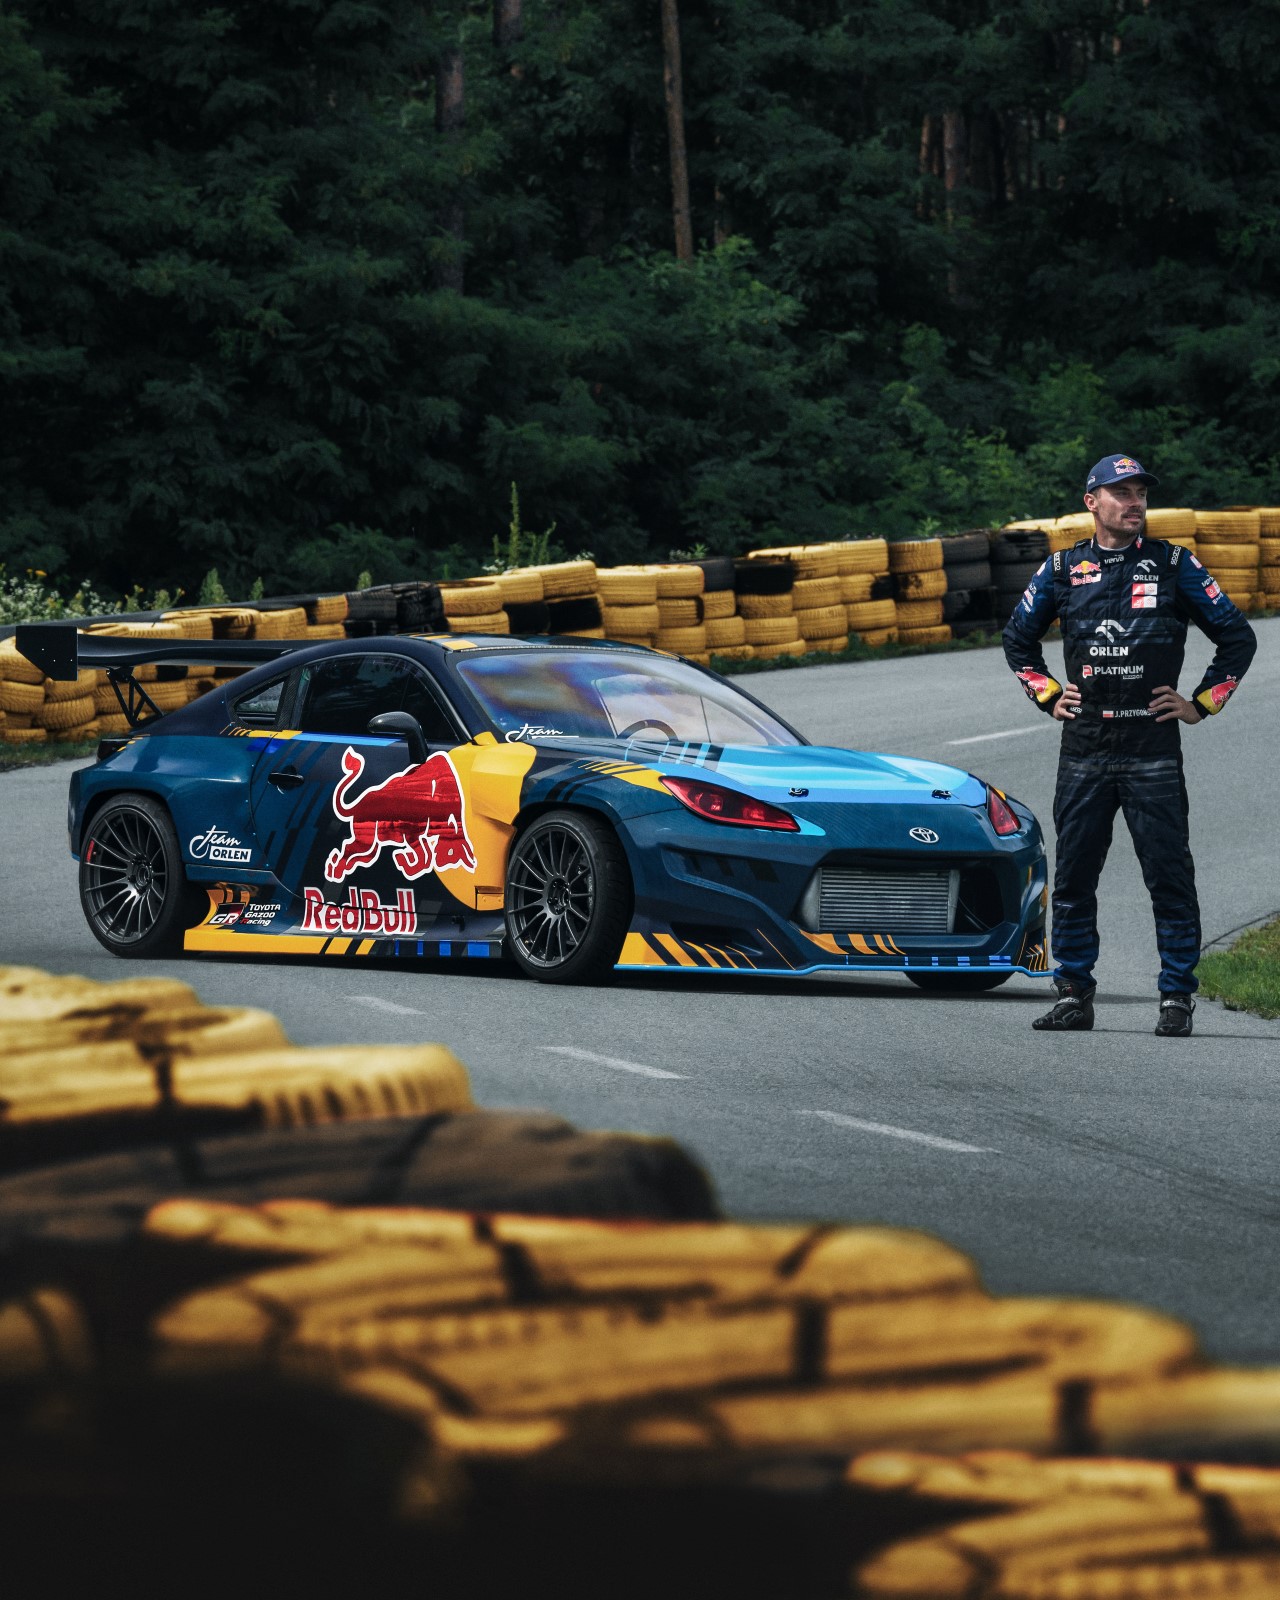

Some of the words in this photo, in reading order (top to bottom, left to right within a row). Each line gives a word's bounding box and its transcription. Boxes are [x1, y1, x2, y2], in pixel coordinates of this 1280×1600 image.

[1133, 574, 1159, 582] ORLEN
[1089, 646, 1129, 657] ORLEN
[1094, 665, 1144, 675] PLATINUM
[211, 848, 250, 860] ORLEN
[249, 903, 281, 911] TOYOTA
[209, 913, 239, 924] GR
[240, 918, 272, 926] Racing
